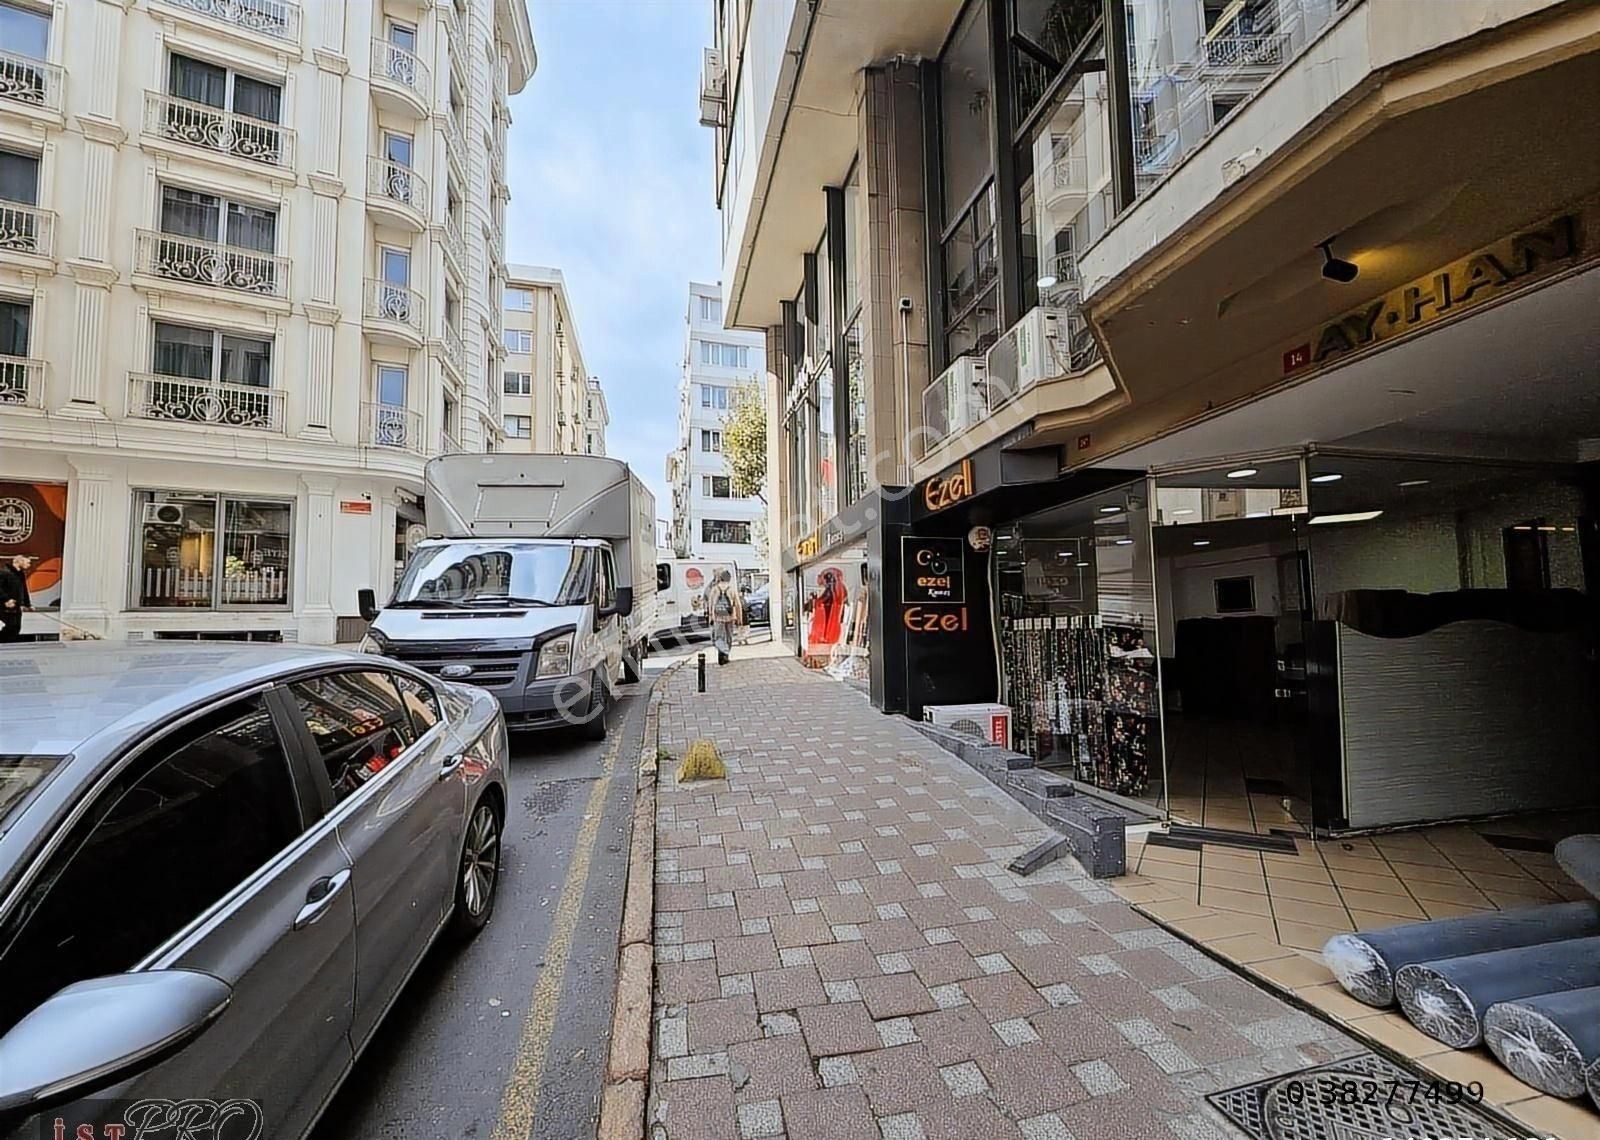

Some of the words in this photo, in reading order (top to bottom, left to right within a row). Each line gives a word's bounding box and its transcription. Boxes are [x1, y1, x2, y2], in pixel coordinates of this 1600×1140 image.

[925, 458, 973, 511] Ezel
[917, 575, 951, 589] ezel
[904, 607, 968, 631] Ezel
